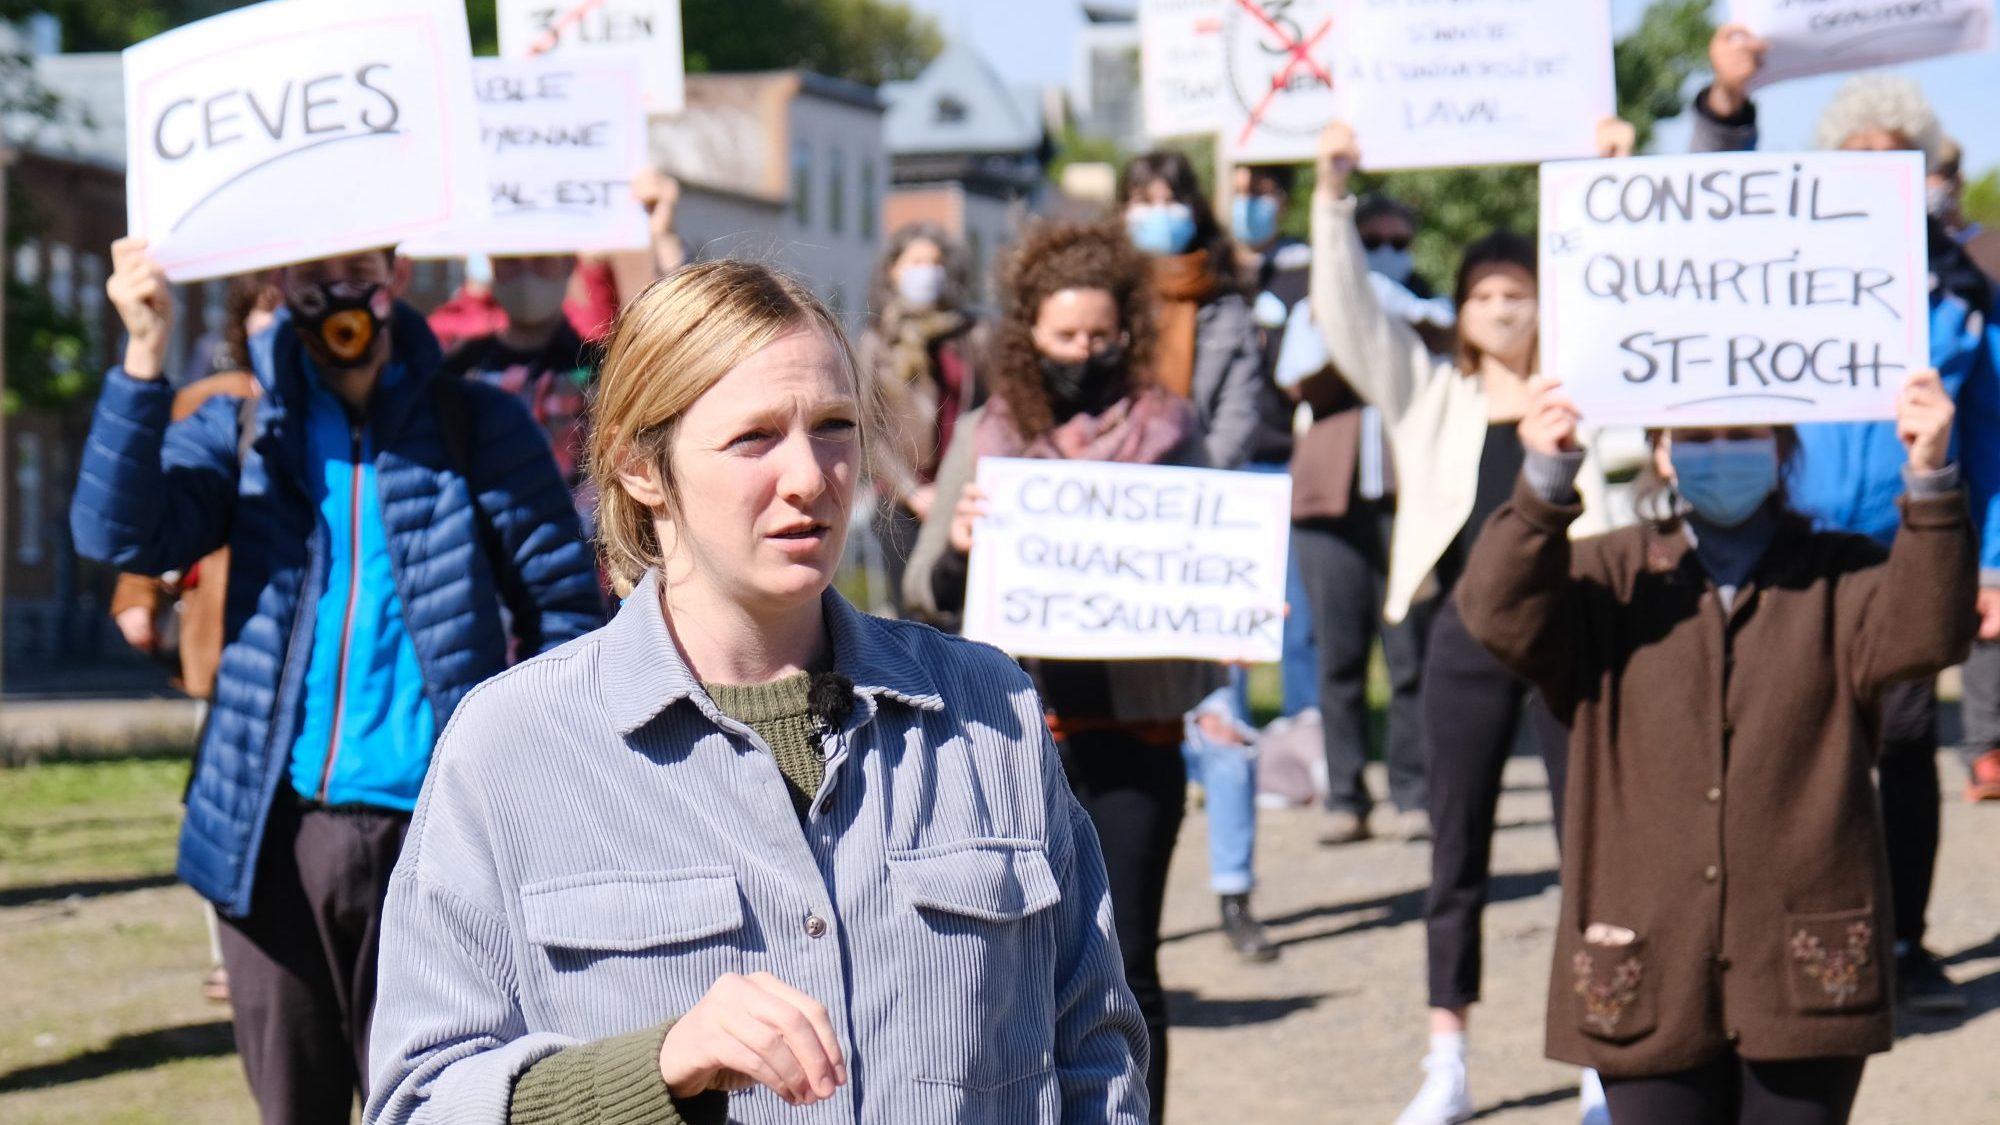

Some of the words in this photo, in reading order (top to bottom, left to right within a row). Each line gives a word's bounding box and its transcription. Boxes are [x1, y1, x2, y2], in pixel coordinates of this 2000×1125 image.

[154, 63, 401, 160] CEVES
[1550, 230, 1582, 254] DE
[1619, 331, 1906, 388] ST-ROCH
